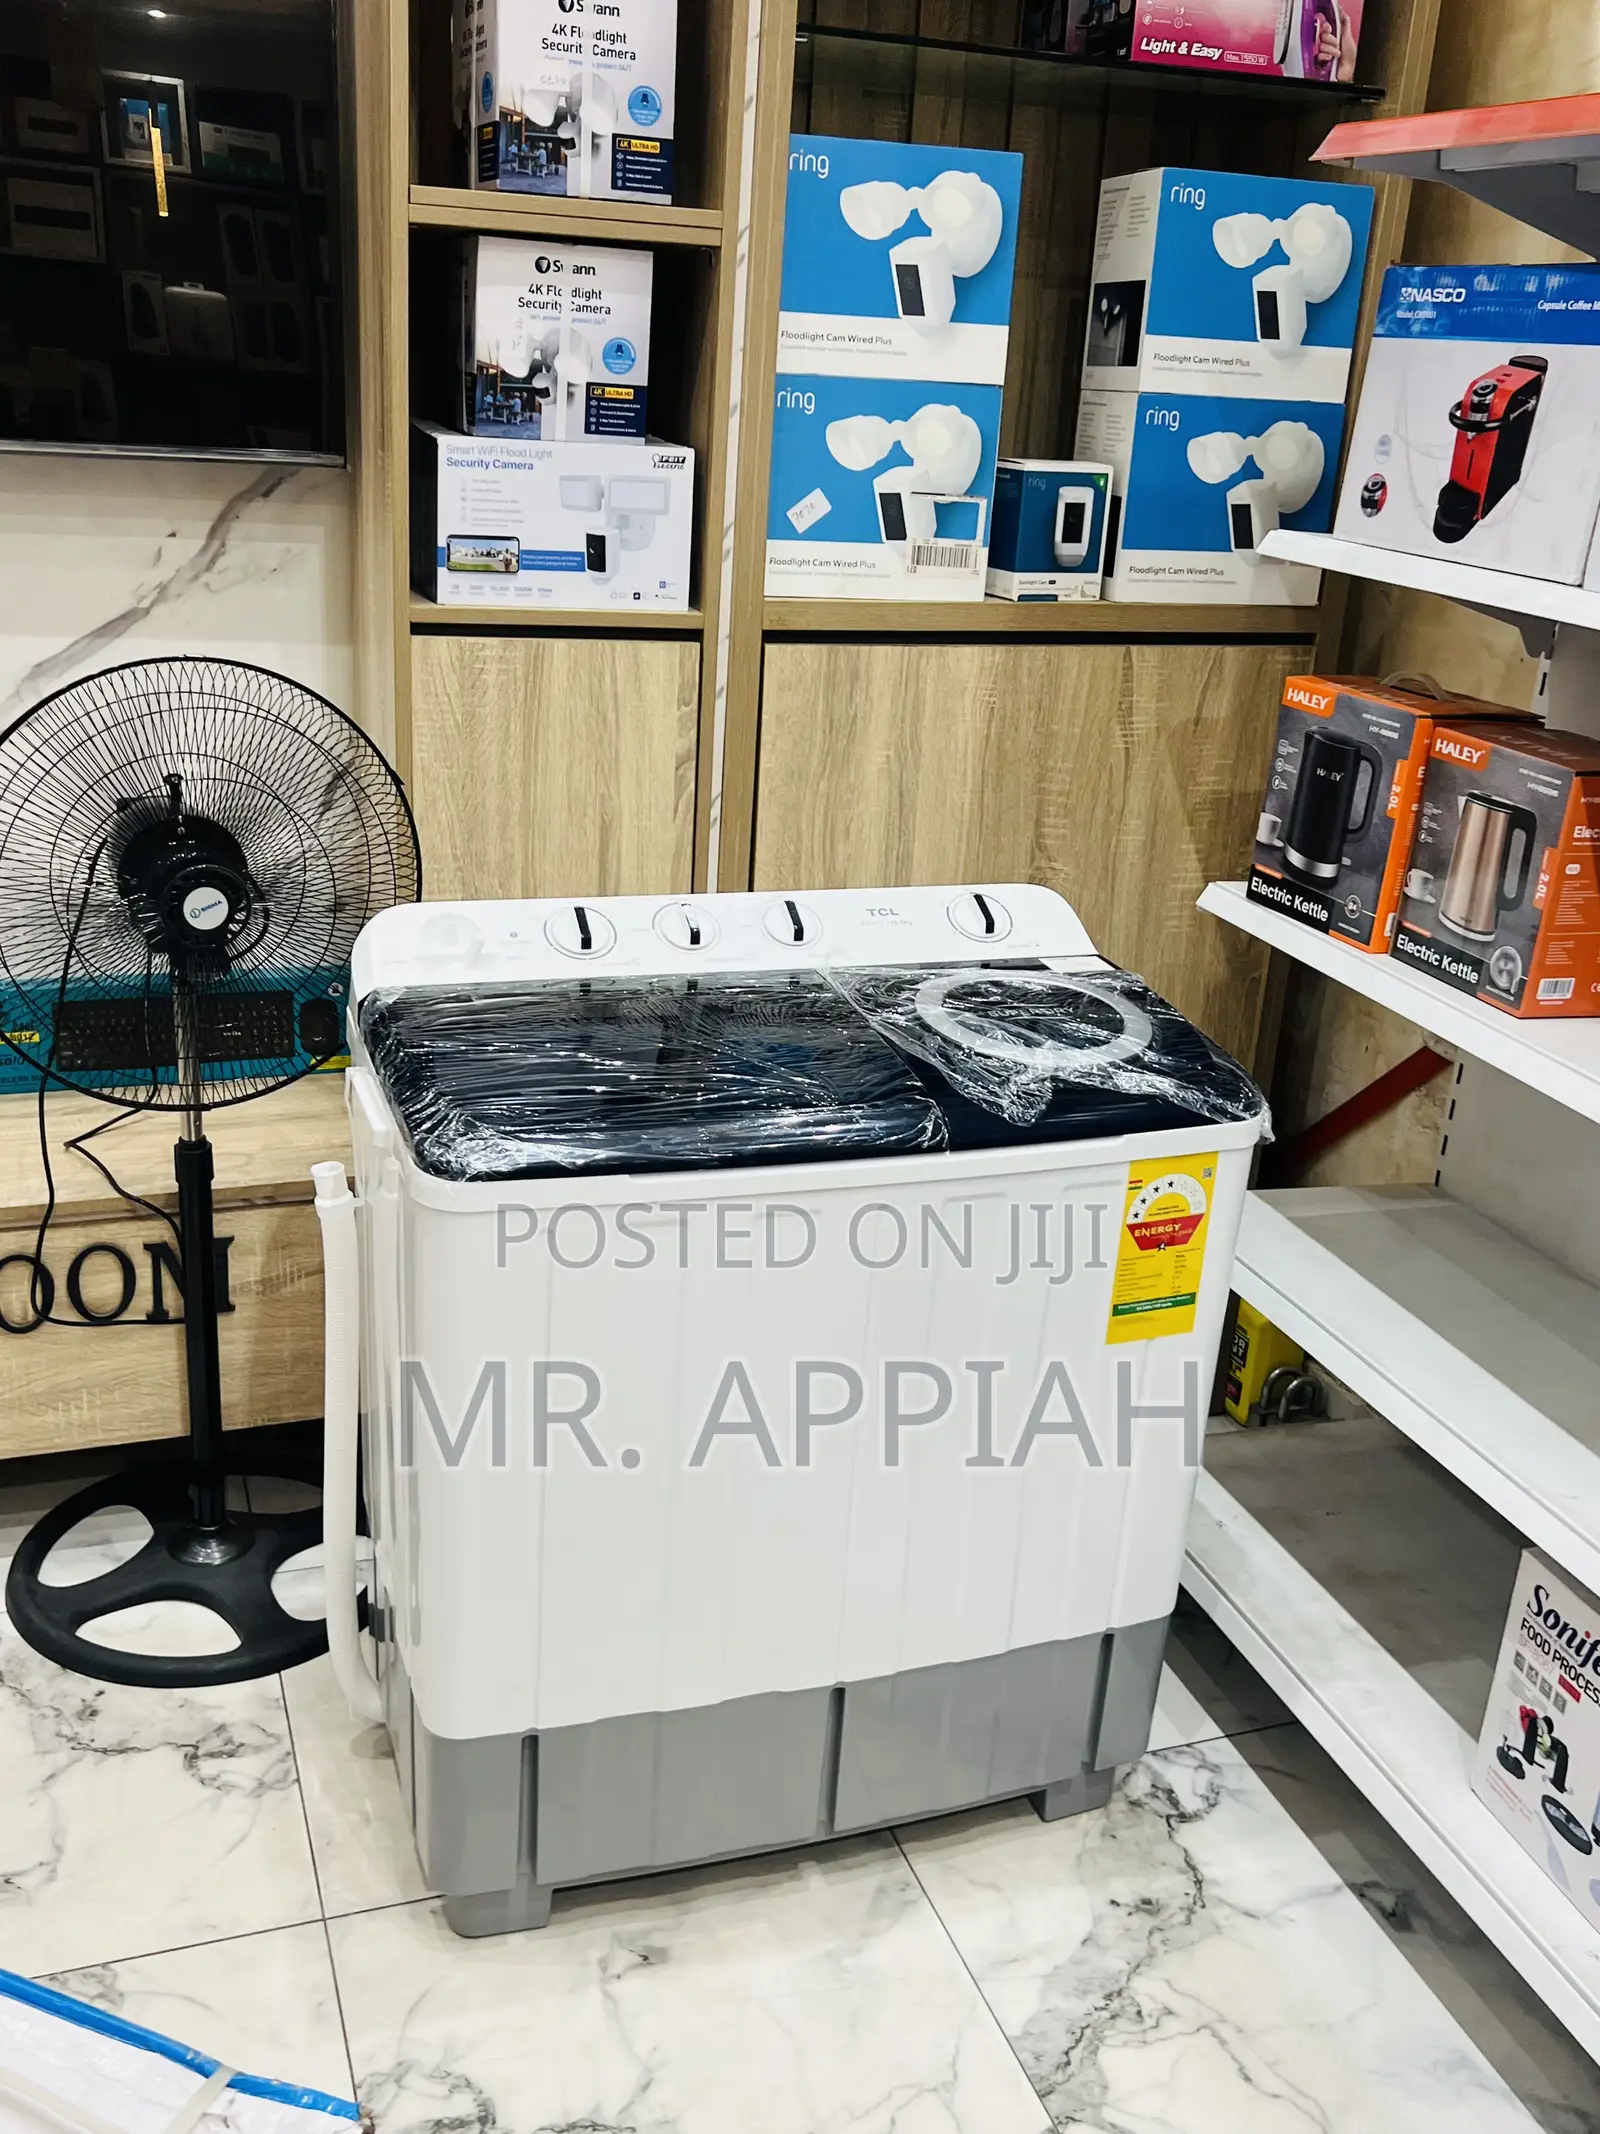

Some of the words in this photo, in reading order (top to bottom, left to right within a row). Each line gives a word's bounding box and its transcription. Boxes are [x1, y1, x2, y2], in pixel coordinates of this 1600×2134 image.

[576, 0, 620, 17] Sann
[552, 23, 567, 36] 4K
[570, 26, 627, 45] Fldlight
[541, 38, 583, 54] Securit
[592, 44, 636, 60] Camera
[1140, 37, 1177, 54] Light
[1178, 41, 1188, 54] &
[1190, 43, 1223, 60] Easy
[789, 149, 829, 179] ring
[1170, 182, 1206, 211] ring
[552, 259, 596, 276] Sann
[528, 283, 543, 295] 4K
[546, 285, 602, 301] Flodlight
[1410, 287, 1466, 303] NASCO
[1537, 299, 1567, 312] Capsule
[1567, 300, 1592, 310] Coffee
[781, 330, 824, 342] Floodlight
[826, 333, 845, 342] Cam
[848, 335, 873, 344] Wired
[875, 335, 892, 345] Plus
[1153, 353, 1191, 364] Floodlight
[1193, 356, 1210, 365] Cam
[1211, 357, 1234, 366] Wired
[1235, 358, 1250, 367] Plus
[777, 387, 815, 415] ring
[1145, 405, 1180, 432] ring
[446, 444, 475, 455] Smart
[477, 446, 498, 456] WiFi
[500, 446, 527, 458] Flood
[529, 448, 552, 461] Light
[446, 457, 490, 471] Security
[492, 459, 534, 471] Camera
[1028, 477, 1046, 491] ring
[769, 557, 811, 568] Floodlight
[812, 559, 831, 567] Cam
[833, 560, 858, 568] Wired
[859, 560, 876, 569] Plus
[1129, 566, 1167, 576] Floodlight
[1167, 567, 1185, 575] Cam
[1186, 567, 1209, 576] Wired
[1209, 568, 1225, 576] Plus
[1287, 687, 1330, 710] HALEY
[1435, 738, 1483, 764] HALEY
[1387, 783, 1401, 810] 2.0L
[1535, 872, 1550, 899] 2.0L
[1251, 876, 1293, 906] Electric
[1293, 895, 1329, 922] Kettle
[865, 908, 900, 917] TCL
[1396, 934, 1440, 966] Electric
[1441, 954, 1479, 984] Kettle
[1134, 1223, 1182, 1237] ENERGY
[1521, 1617, 1551, 1656] FOOD
[1552, 1649, 1600, 1707] PROCES
